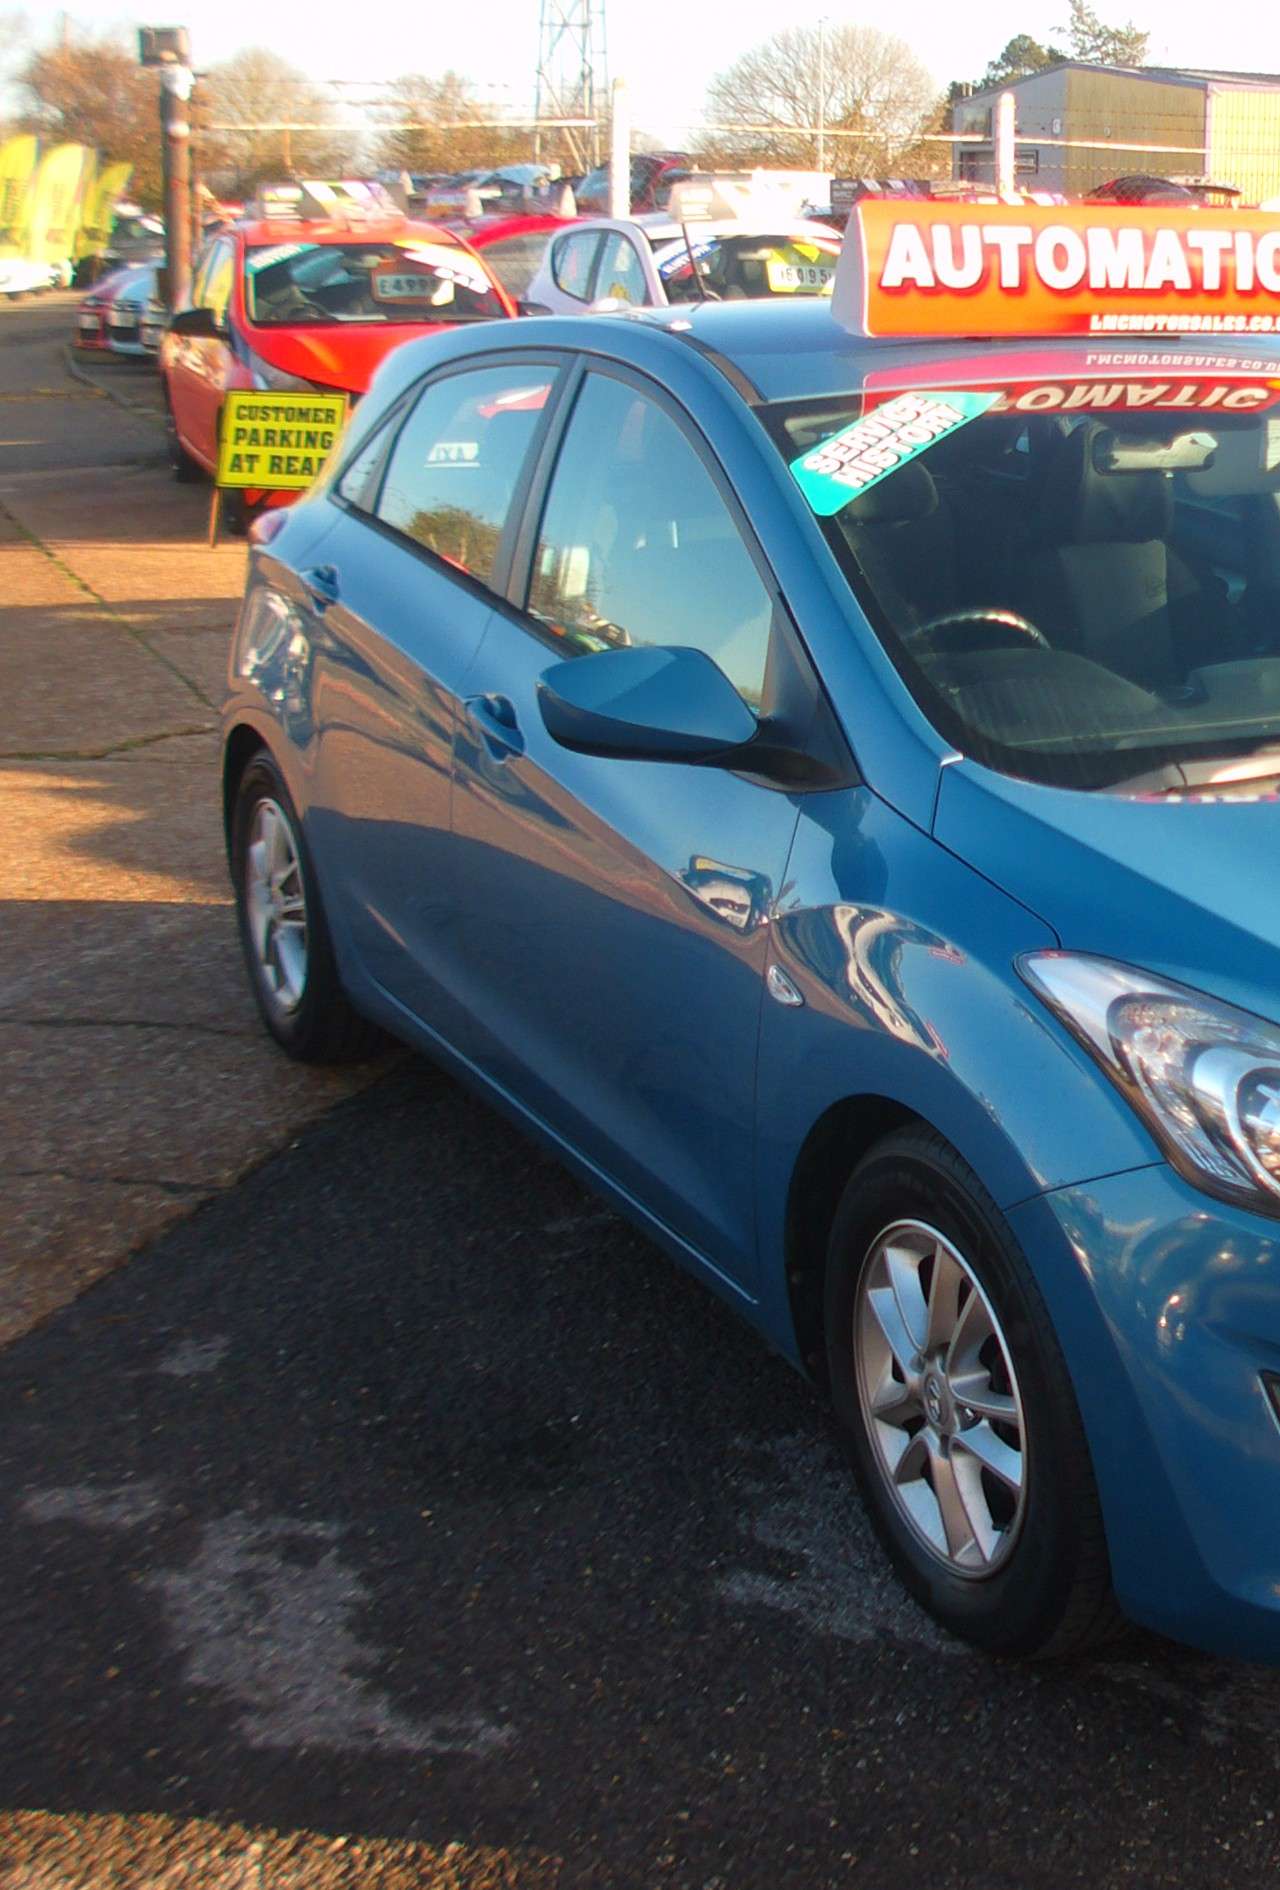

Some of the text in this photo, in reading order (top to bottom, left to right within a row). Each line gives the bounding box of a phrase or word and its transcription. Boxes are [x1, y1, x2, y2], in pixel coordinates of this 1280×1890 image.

[236, 404, 337, 425] CUSTOMER
[233, 427, 334, 450] PARKING
[803, 394, 937, 474] SERVICE
[831, 402, 968, 490] HISTORY
[229, 453, 260, 473] AT
